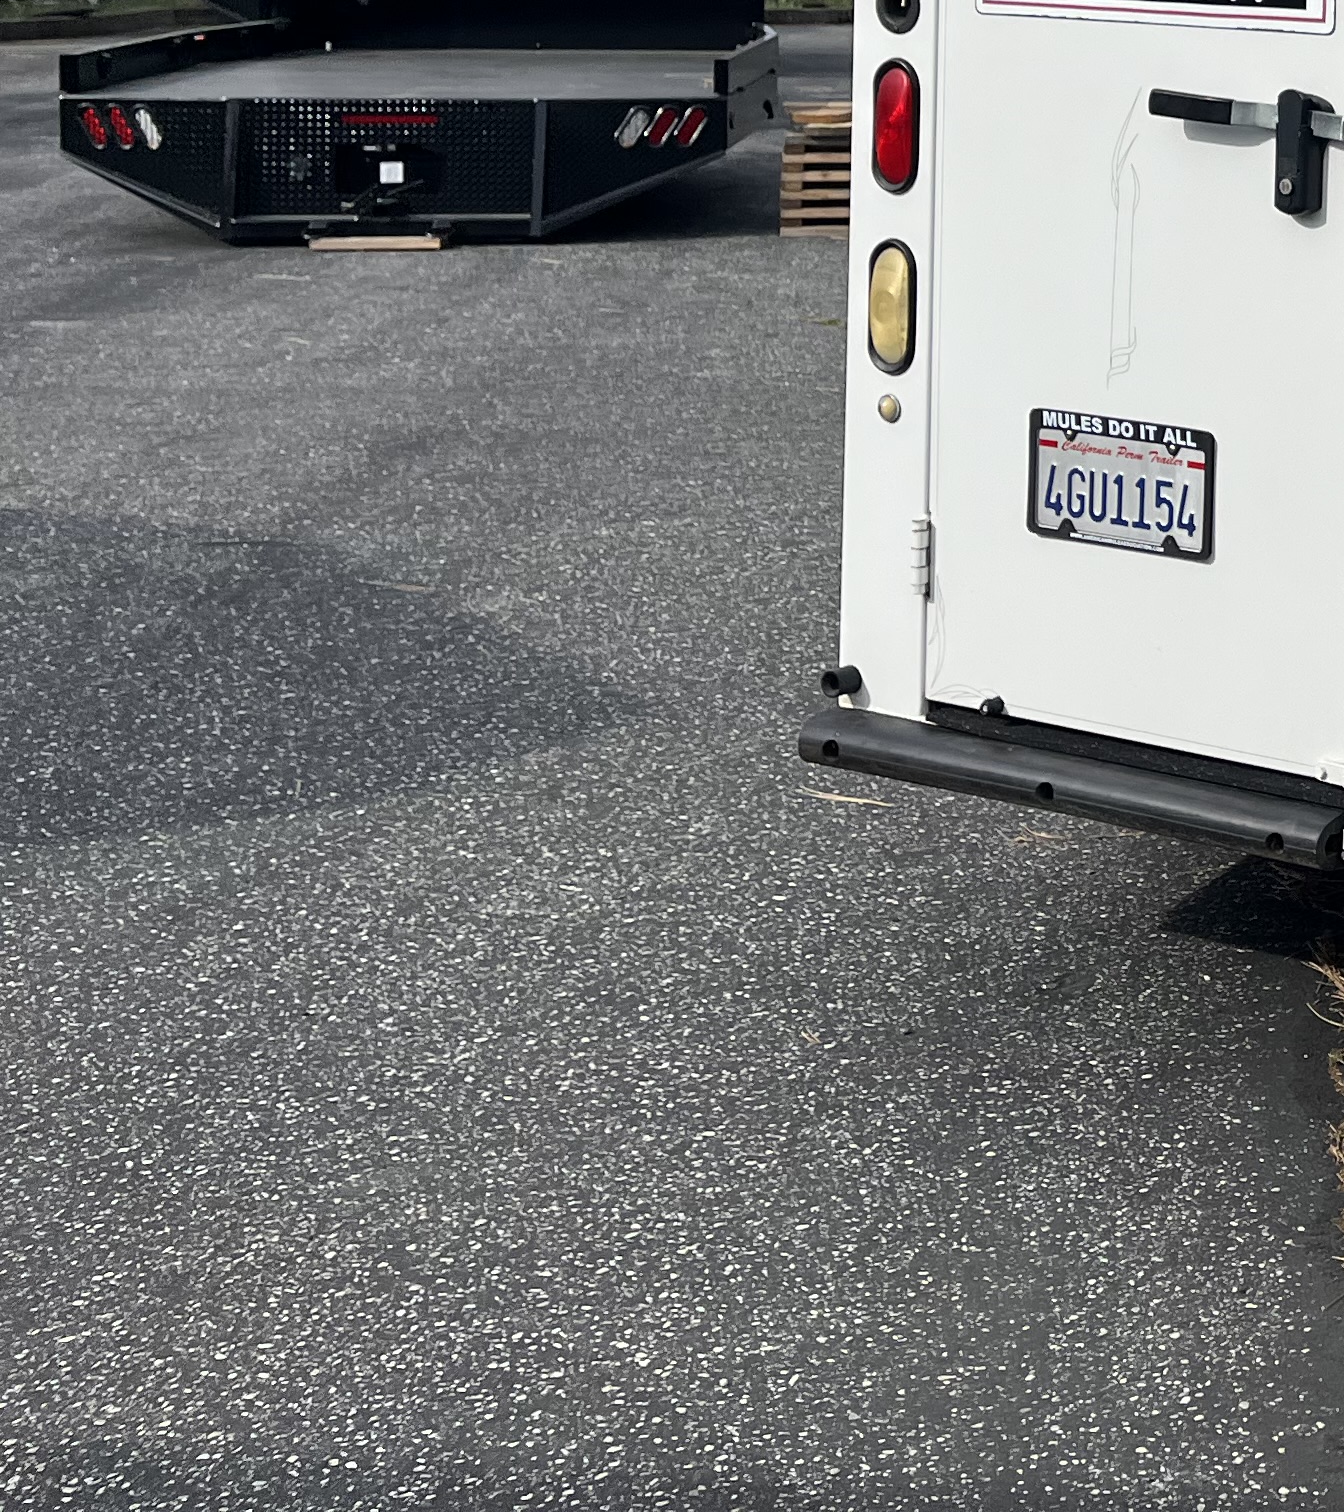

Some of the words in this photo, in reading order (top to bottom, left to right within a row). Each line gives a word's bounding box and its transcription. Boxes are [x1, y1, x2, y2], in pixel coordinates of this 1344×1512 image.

[1042, 410, 1104, 434] MULES
[1108, 419, 1134, 438] DO
[1139, 423, 1158, 441] IT
[1162, 428, 1197, 448] ALL
[1061, 439, 1113, 456] California
[1115, 445, 1144, 462] Perm
[1148, 450, 1184, 467] Trailer
[1044, 461, 1197, 538] 4GU1154
